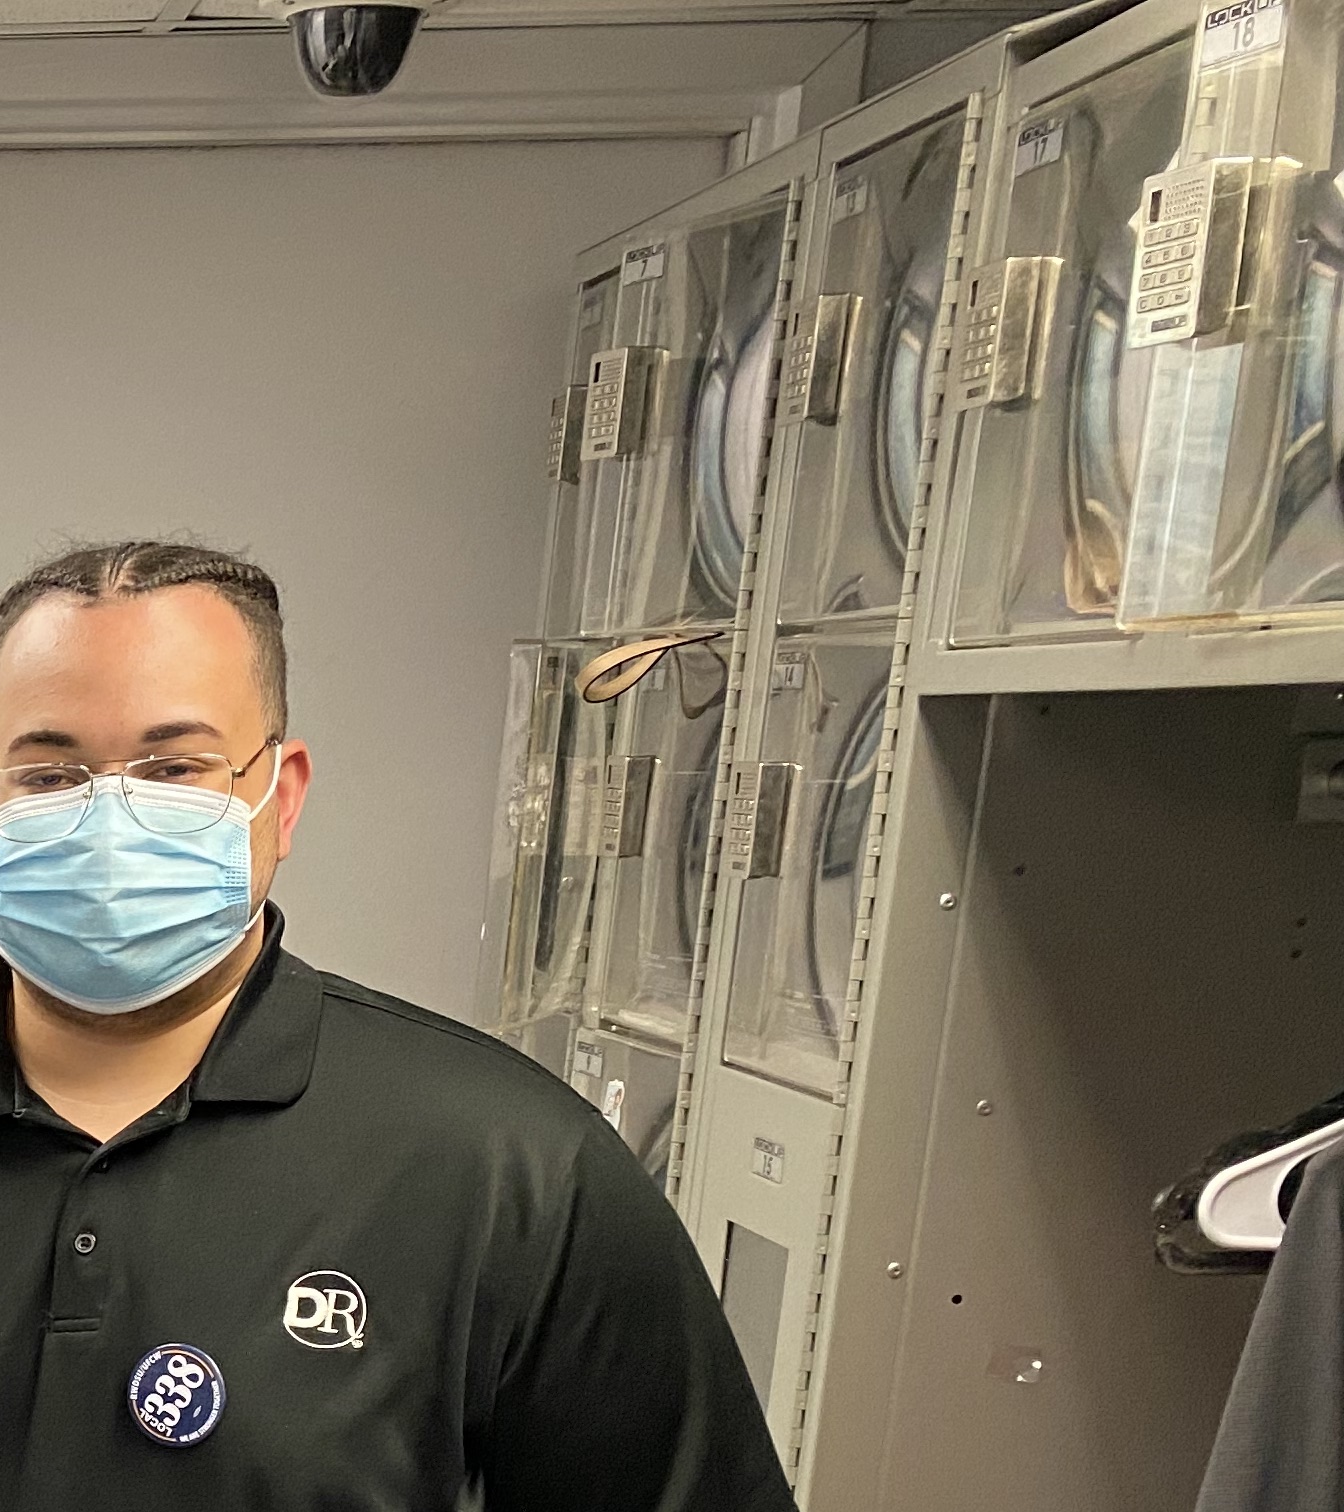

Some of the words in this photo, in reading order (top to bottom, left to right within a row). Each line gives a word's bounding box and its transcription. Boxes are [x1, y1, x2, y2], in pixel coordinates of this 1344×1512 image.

[1233, 17, 1255, 51] 18
[1033, 137, 1048, 164] 17
[762, 1154, 773, 1176] 15
[283, 1286, 364, 1339] DR
[129, 1351, 162, 1400] RWDSU/UFCW
[144, 1354, 205, 1427] 338
[139, 1408, 173, 1438] LOCAL
